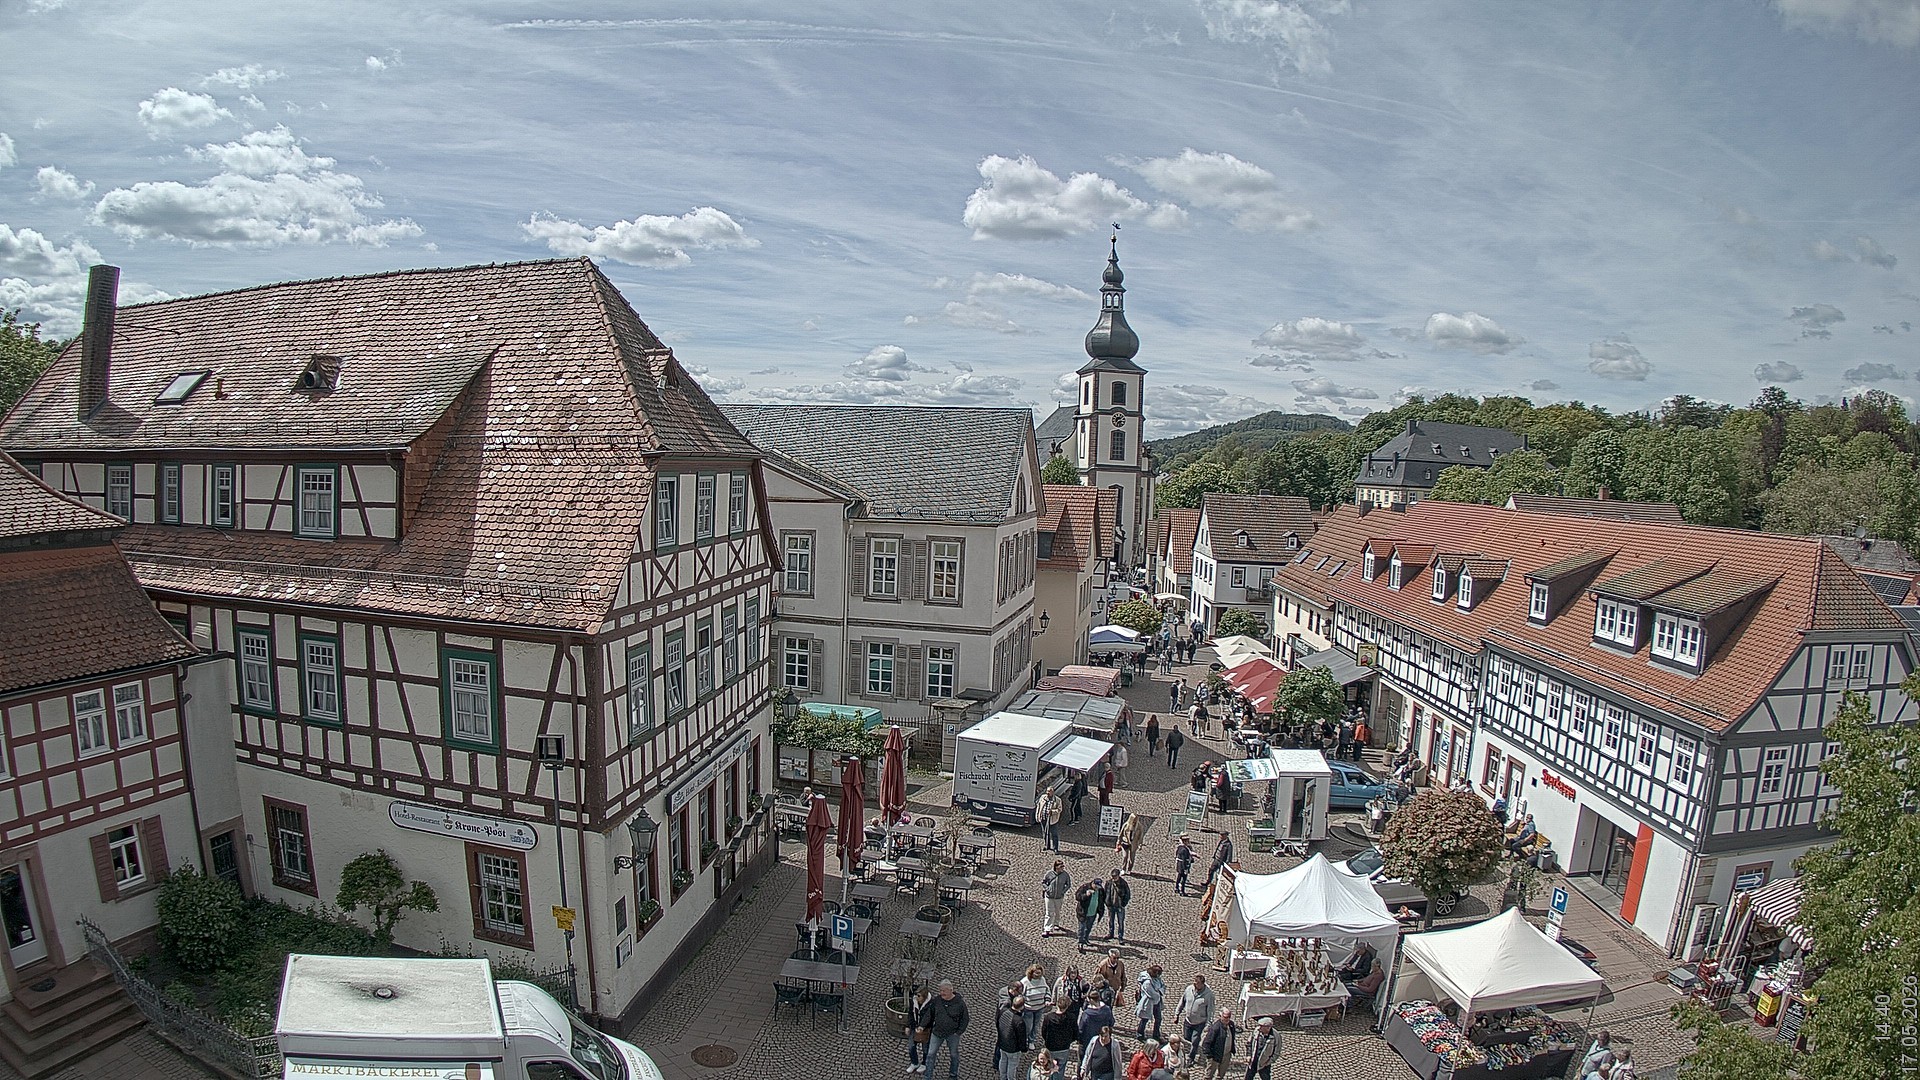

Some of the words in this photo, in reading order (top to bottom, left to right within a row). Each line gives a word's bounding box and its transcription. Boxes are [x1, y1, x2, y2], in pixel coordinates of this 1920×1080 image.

[959, 771, 992, 780] Fischzucht
[996, 772, 1032, 782] Forellenhof
[1553, 890, 1564, 907] P
[836, 918, 848, 935] P
[291, 1063, 440, 1077] MARKTBÄCKEREI
